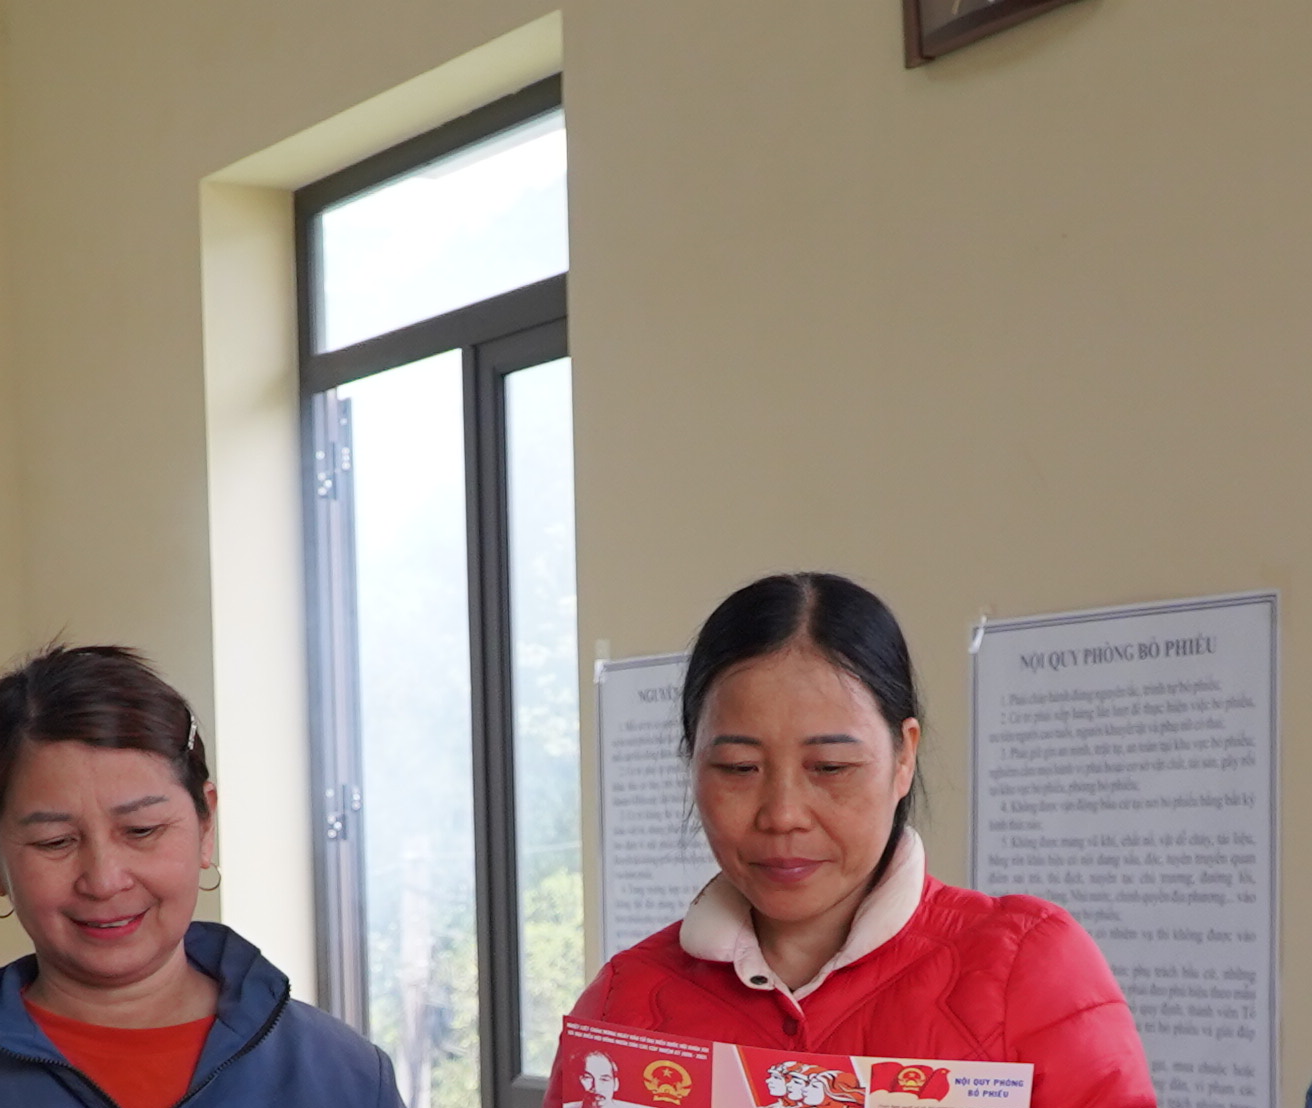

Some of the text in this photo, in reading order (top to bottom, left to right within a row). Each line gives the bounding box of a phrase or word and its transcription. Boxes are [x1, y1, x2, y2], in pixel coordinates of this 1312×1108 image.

[1020, 633, 1217, 672] NỘI QUY PHÒNG BỎ PHIẾU
[955, 1077, 970, 1086] NỘI
[994, 1079, 1024, 1087] PHÒNG
